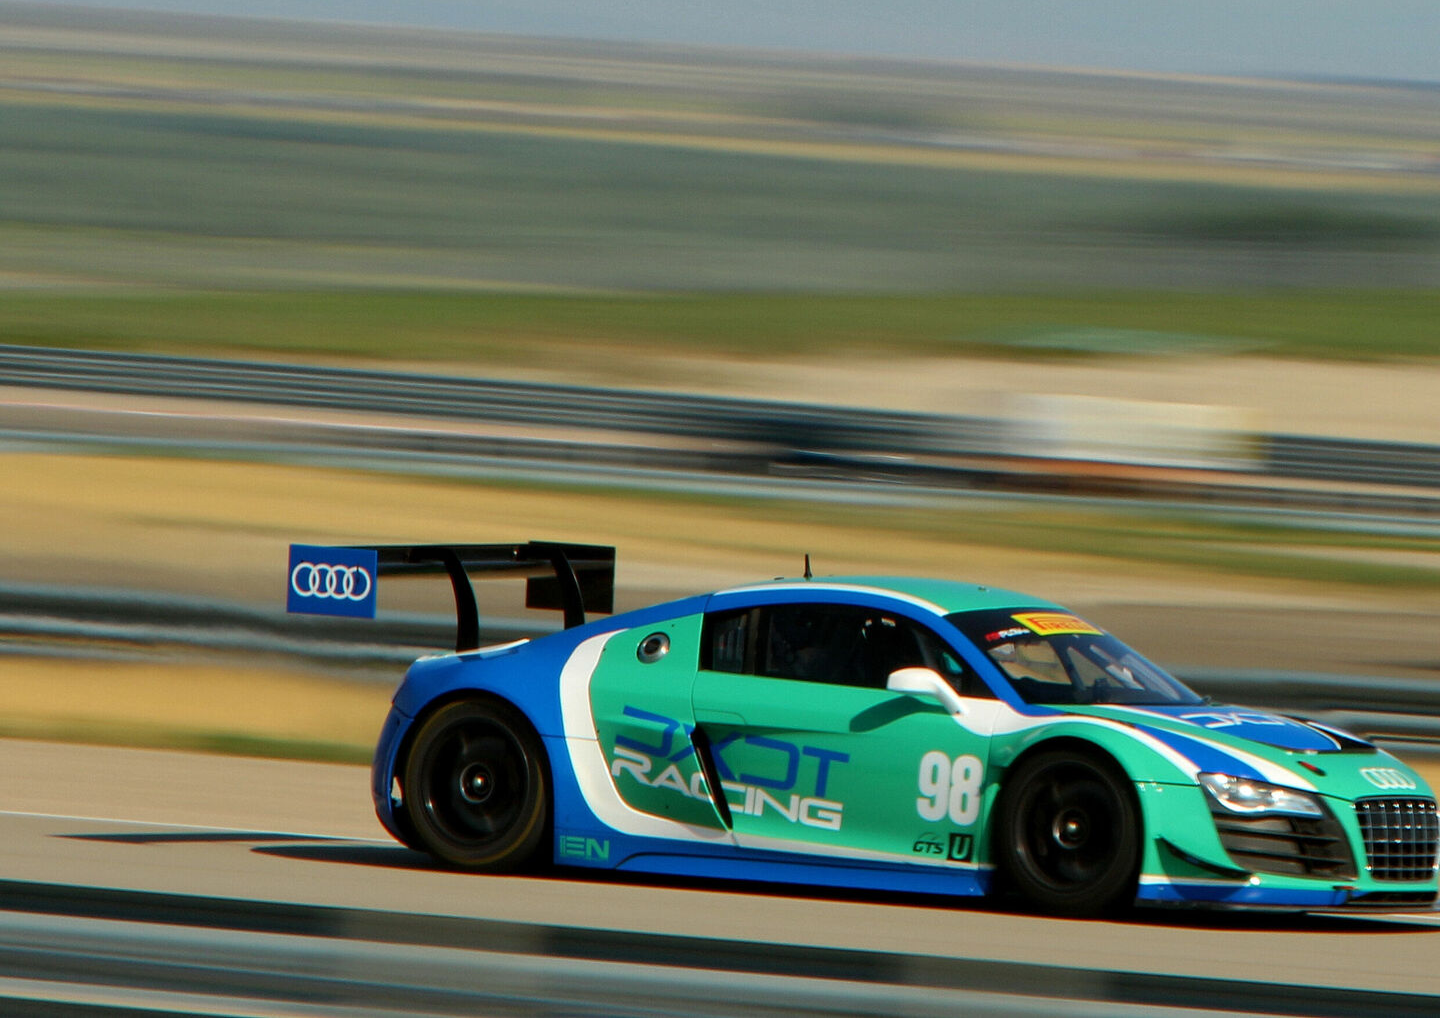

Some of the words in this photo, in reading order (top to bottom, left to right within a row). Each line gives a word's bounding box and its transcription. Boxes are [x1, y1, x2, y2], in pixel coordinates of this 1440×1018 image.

[612, 746, 844, 831] RACING
[916, 750, 983, 826] 98
[912, 840, 944, 854] GTS
